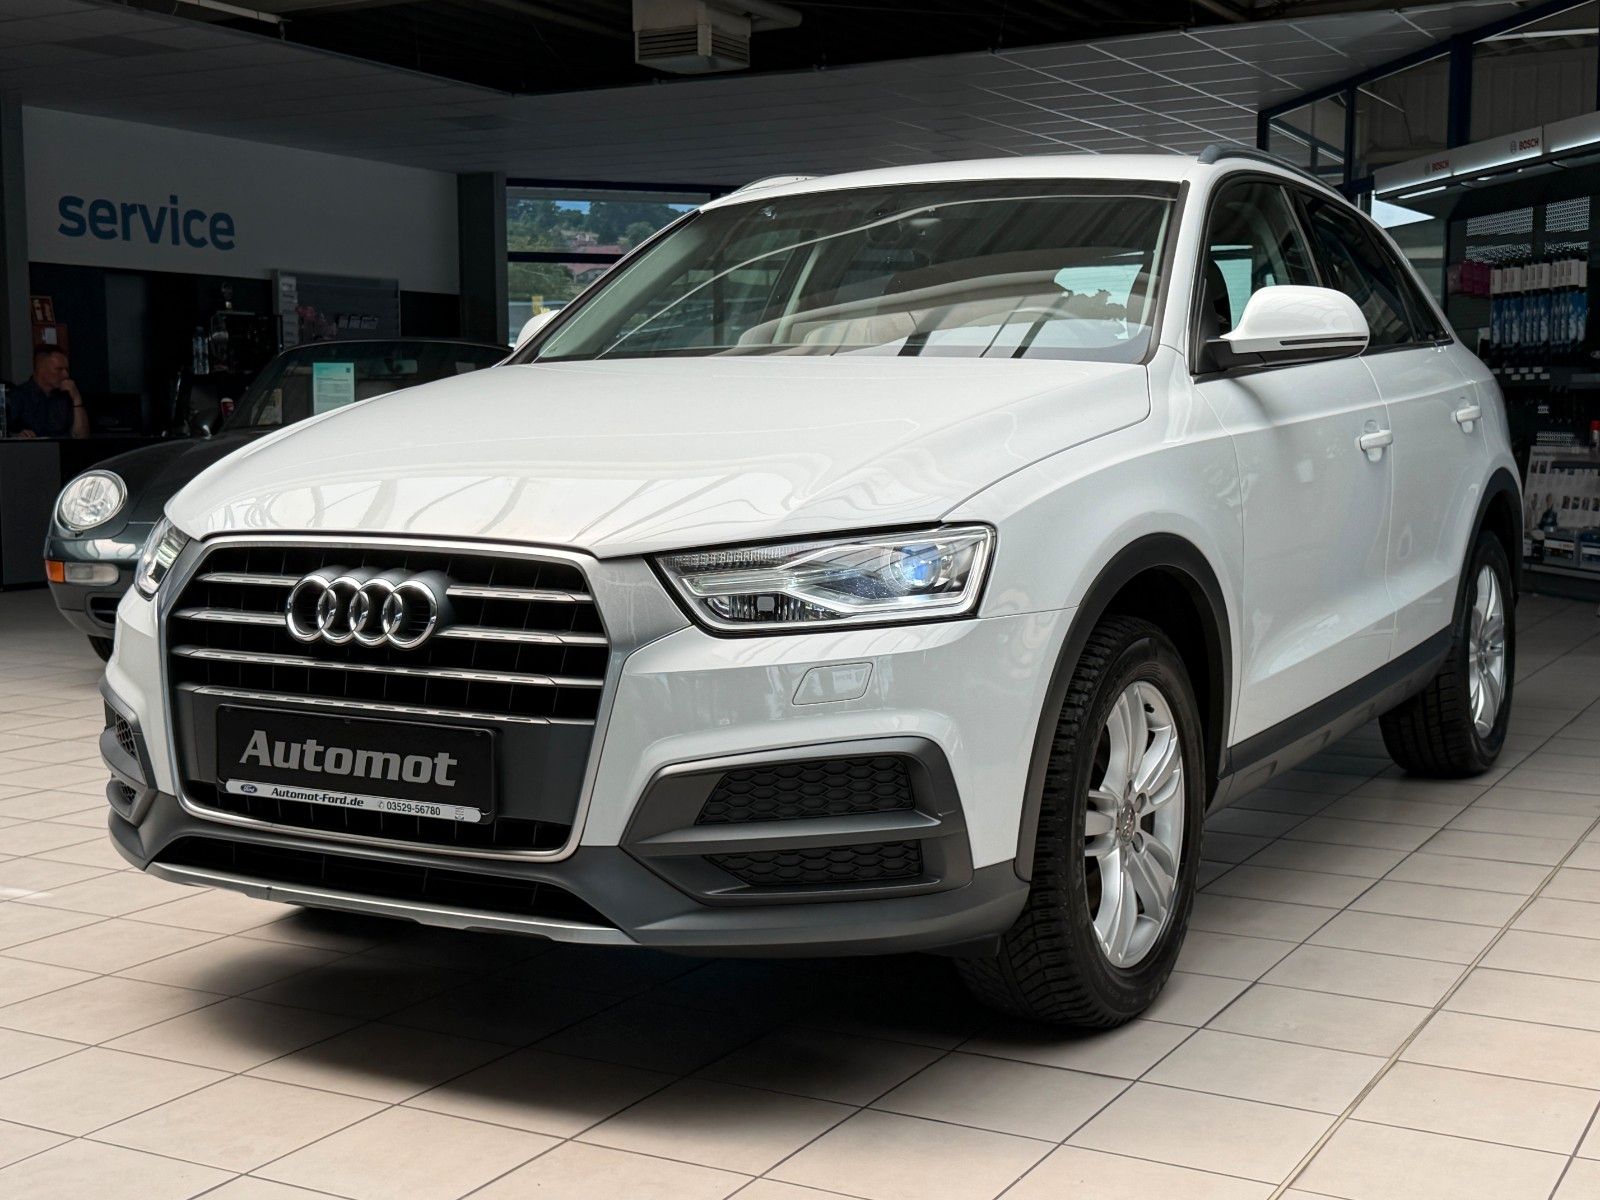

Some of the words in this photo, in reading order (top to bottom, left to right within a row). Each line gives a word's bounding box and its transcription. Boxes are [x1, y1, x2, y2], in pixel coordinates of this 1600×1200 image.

[58, 194, 235, 250] service
[239, 730, 457, 786] Automot
[241, 783, 257, 794] Ford
[271, 787, 364, 807] Automot-Ford.de
[386, 800, 441, 816] 03529-56780
